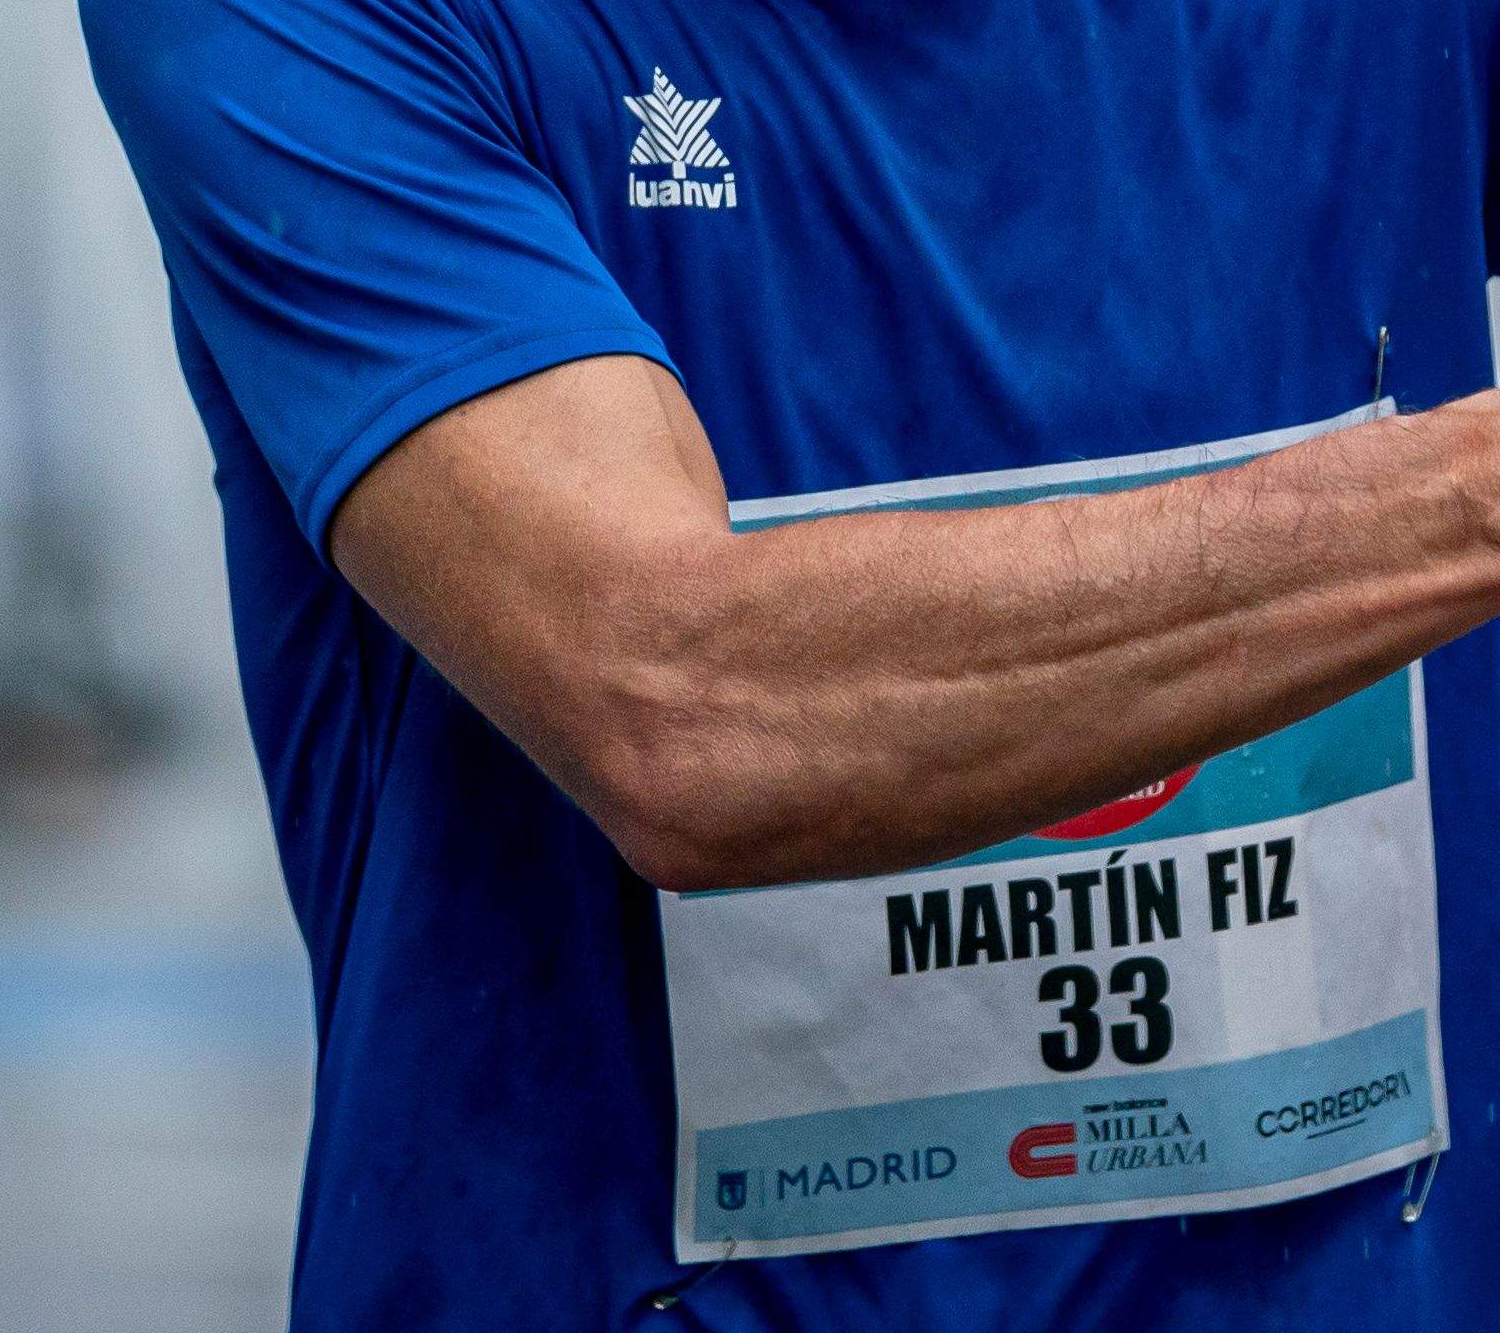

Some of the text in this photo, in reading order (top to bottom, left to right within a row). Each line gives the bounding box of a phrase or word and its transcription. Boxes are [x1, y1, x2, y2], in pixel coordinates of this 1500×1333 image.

[629, 172, 738, 209] luanvi
[886, 836, 1299, 976] MARTÍN FIZ
[1038, 956, 1175, 1073] 33
[1086, 1112, 1192, 1143] MILLA
[776, 1146, 957, 1200] MADRID
[1087, 1139, 1208, 1173] URBANA
